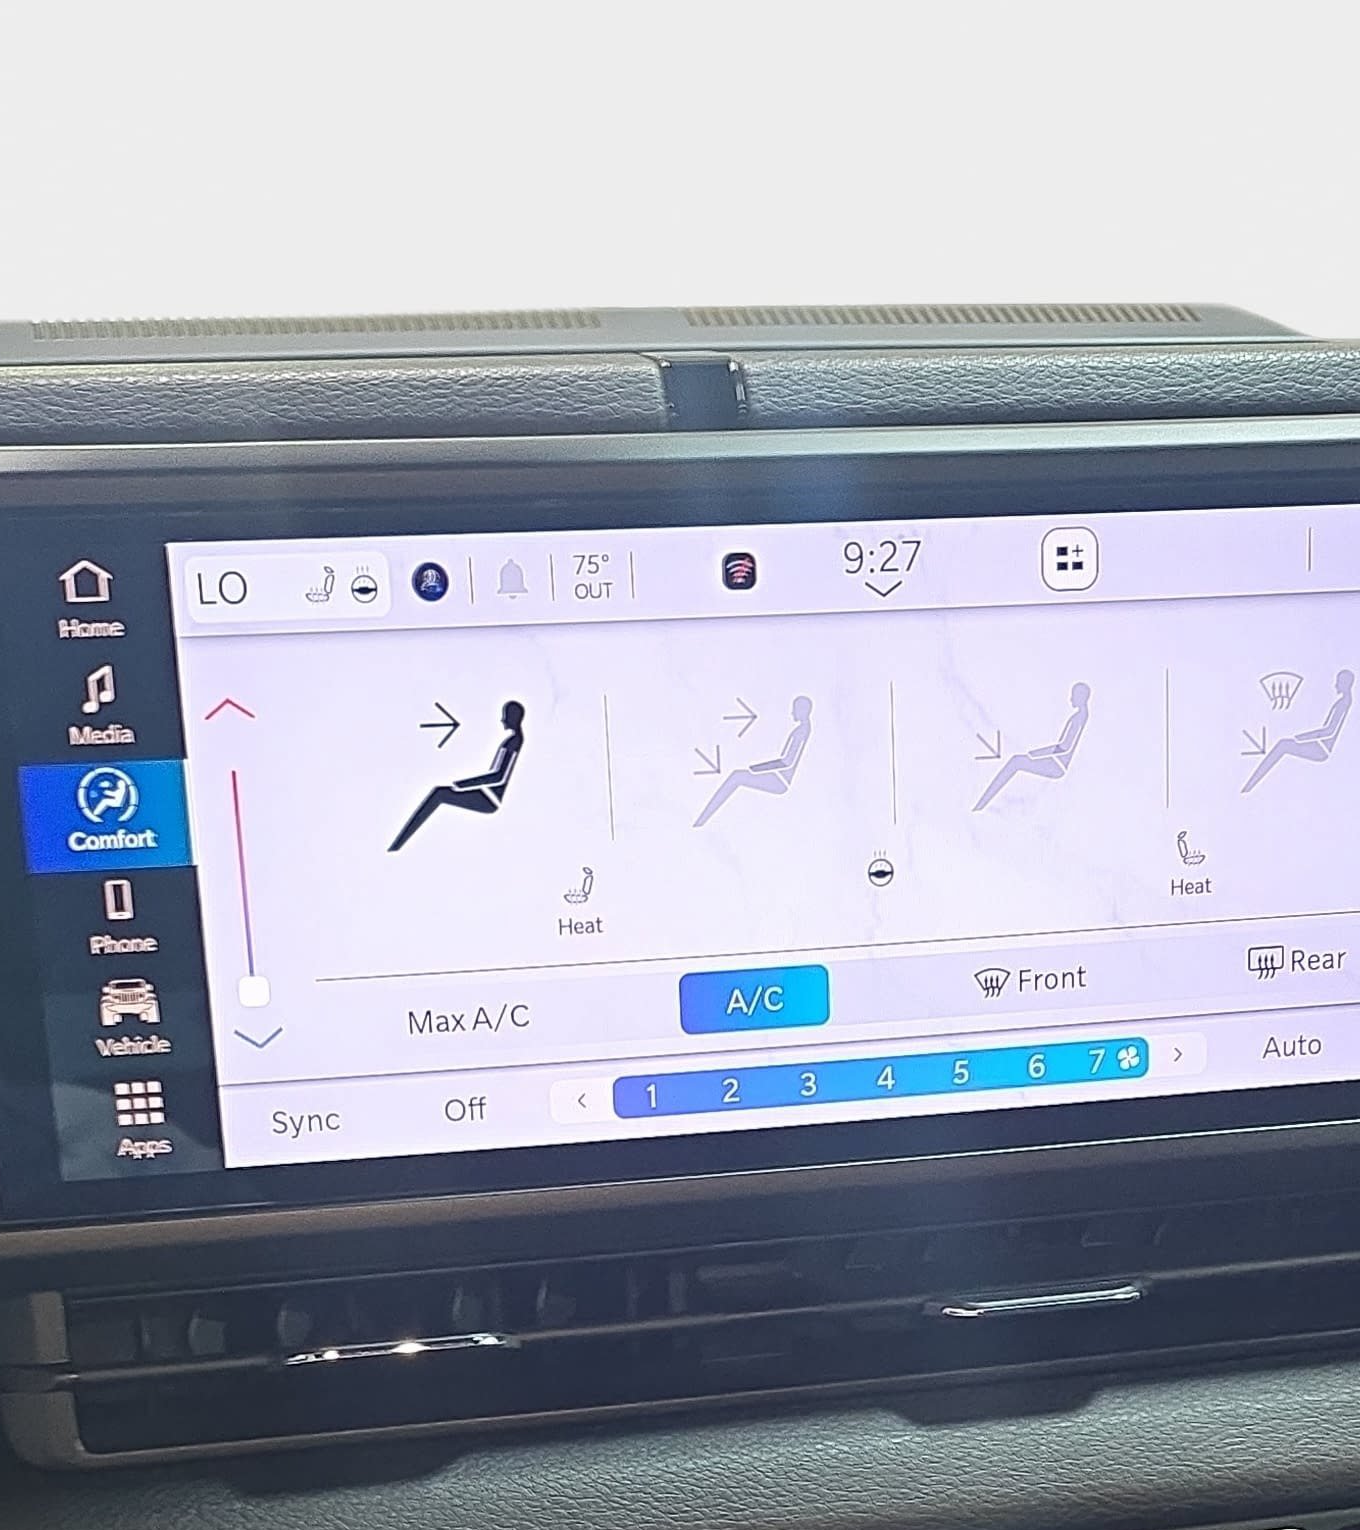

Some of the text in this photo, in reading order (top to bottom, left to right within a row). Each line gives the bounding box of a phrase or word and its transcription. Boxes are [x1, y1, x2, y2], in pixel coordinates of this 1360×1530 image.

[572, 554, 610, 574] 75°
[843, 540, 921, 576] 9:27
[196, 571, 248, 605] LO
[574, 583, 612, 600] OUT
[58, 617, 126, 640] Home
[68, 725, 136, 746] Media
[68, 829, 159, 853] Comfort
[1170, 876, 1213, 896] Heat
[558, 916, 604, 936] Heat
[89, 933, 159, 956] Phone
[1290, 948, 1348, 973] Rear
[1017, 965, 1088, 993] Front
[726, 985, 785, 1016] A/C
[408, 1003, 531, 1036] Max A/C
[95, 1034, 173, 1057] Vehicle
[1261, 1034, 1323, 1060] Auto
[645, 1048, 1106, 1108] 1 2 3 4 5 6 7
[444, 1096, 488, 1121] Off
[272, 1108, 342, 1138] Sync
[117, 1136, 174, 1159] Apps
